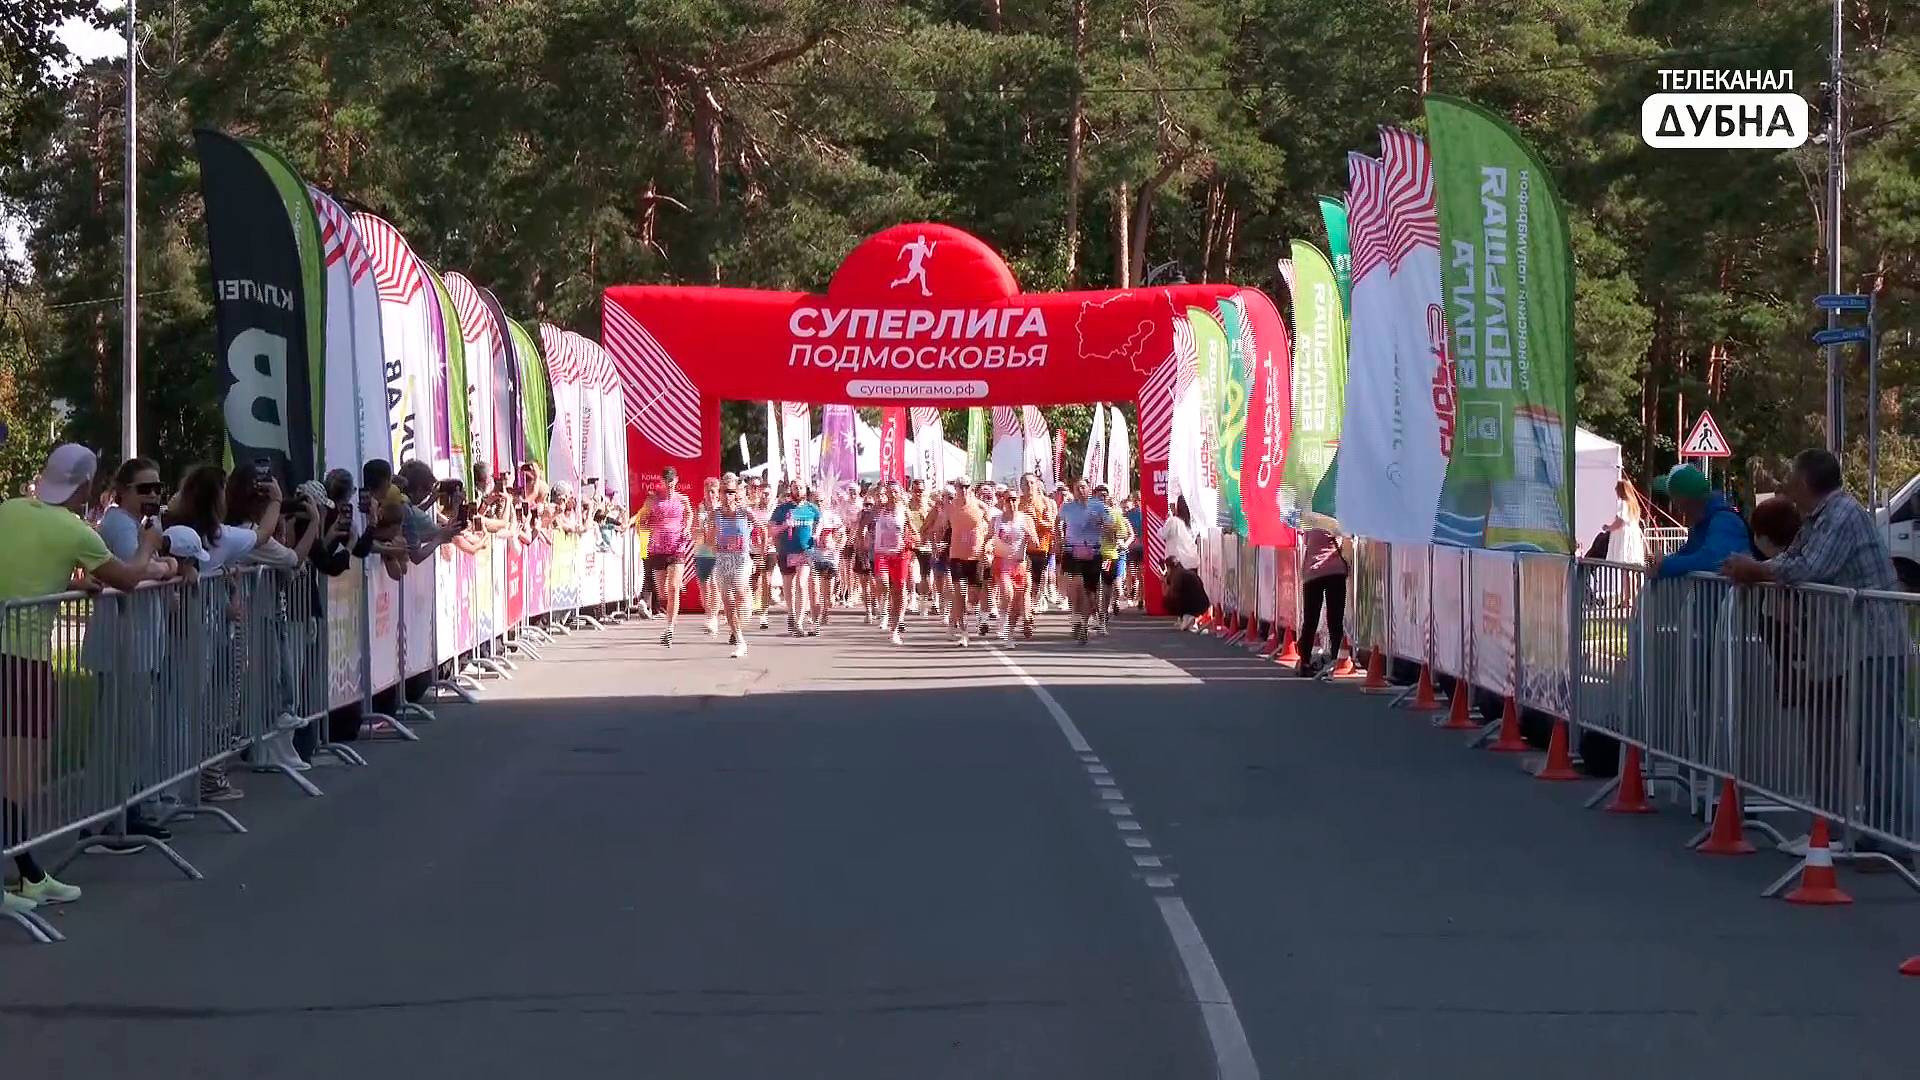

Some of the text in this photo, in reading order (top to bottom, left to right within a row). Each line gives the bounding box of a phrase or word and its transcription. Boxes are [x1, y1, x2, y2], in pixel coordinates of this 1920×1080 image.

[789, 307, 1049, 340] СУПЕРЛИГА
[788, 343, 1049, 372] ПОДМОСКОВЬЯ
[860, 383, 975, 397] суперлигамо.рф
